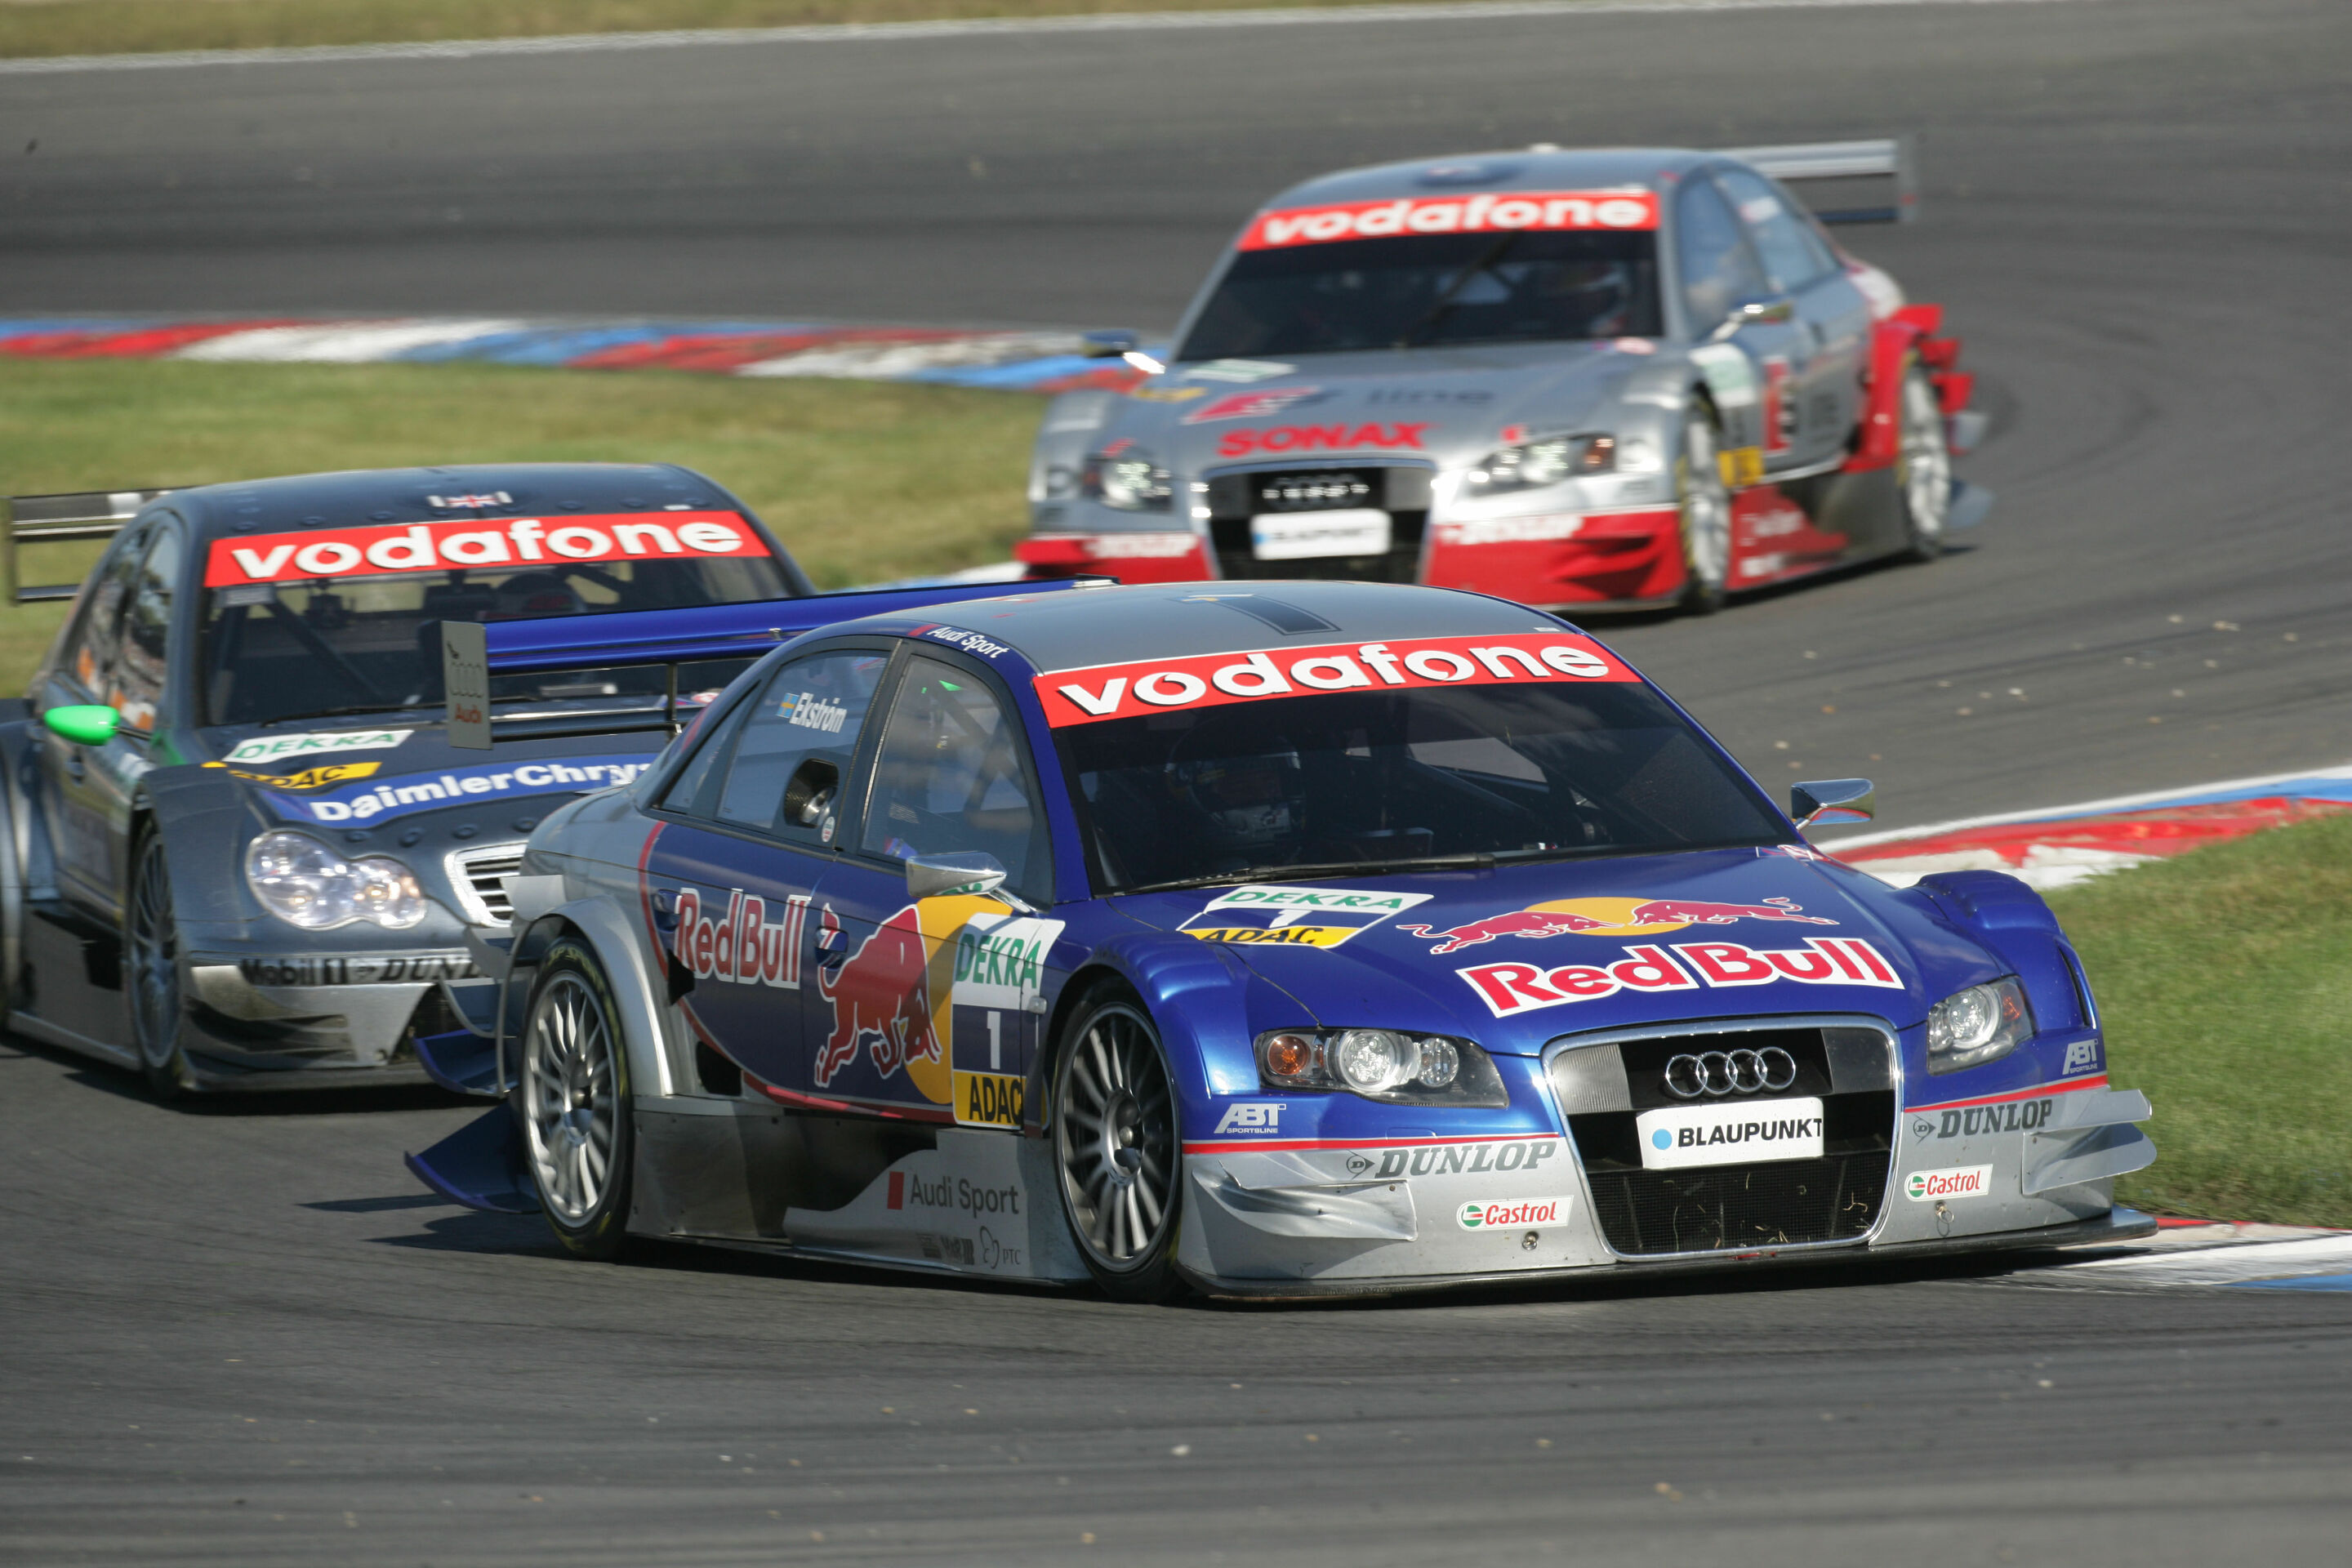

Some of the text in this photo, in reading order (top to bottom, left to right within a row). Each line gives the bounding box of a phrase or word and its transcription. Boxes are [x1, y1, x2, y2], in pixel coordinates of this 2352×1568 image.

[1263, 195, 1649, 244] vodafone
[1217, 421, 1433, 458] SONAX
[232, 519, 742, 579] vodafone
[926, 626, 1010, 659] Audi Sport
[1058, 643, 1610, 716] vodafone
[234, 733, 396, 759] DEKRA
[1222, 890, 1404, 910] DEKRA
[1198, 926, 1324, 945] ADAC
[1269, 909, 1312, 929] 1
[955, 933, 1042, 990] DEKRA
[987, 1010, 1001, 1071] 1
[2062, 1038, 2098, 1076] ABT
[969, 1075, 1024, 1125] ADAC
[1214, 1103, 1279, 1134] ABT
[1677, 1117, 1823, 1148] BLAUPUNKT
[1936, 1099, 2052, 1139] DUNLOP
[1374, 1141, 1557, 1179] DUNLOP
[910, 1174, 1020, 1219] Audi Sport
[1927, 1169, 1980, 1196] Castrol
[1485, 1201, 1557, 1226] Castrol
